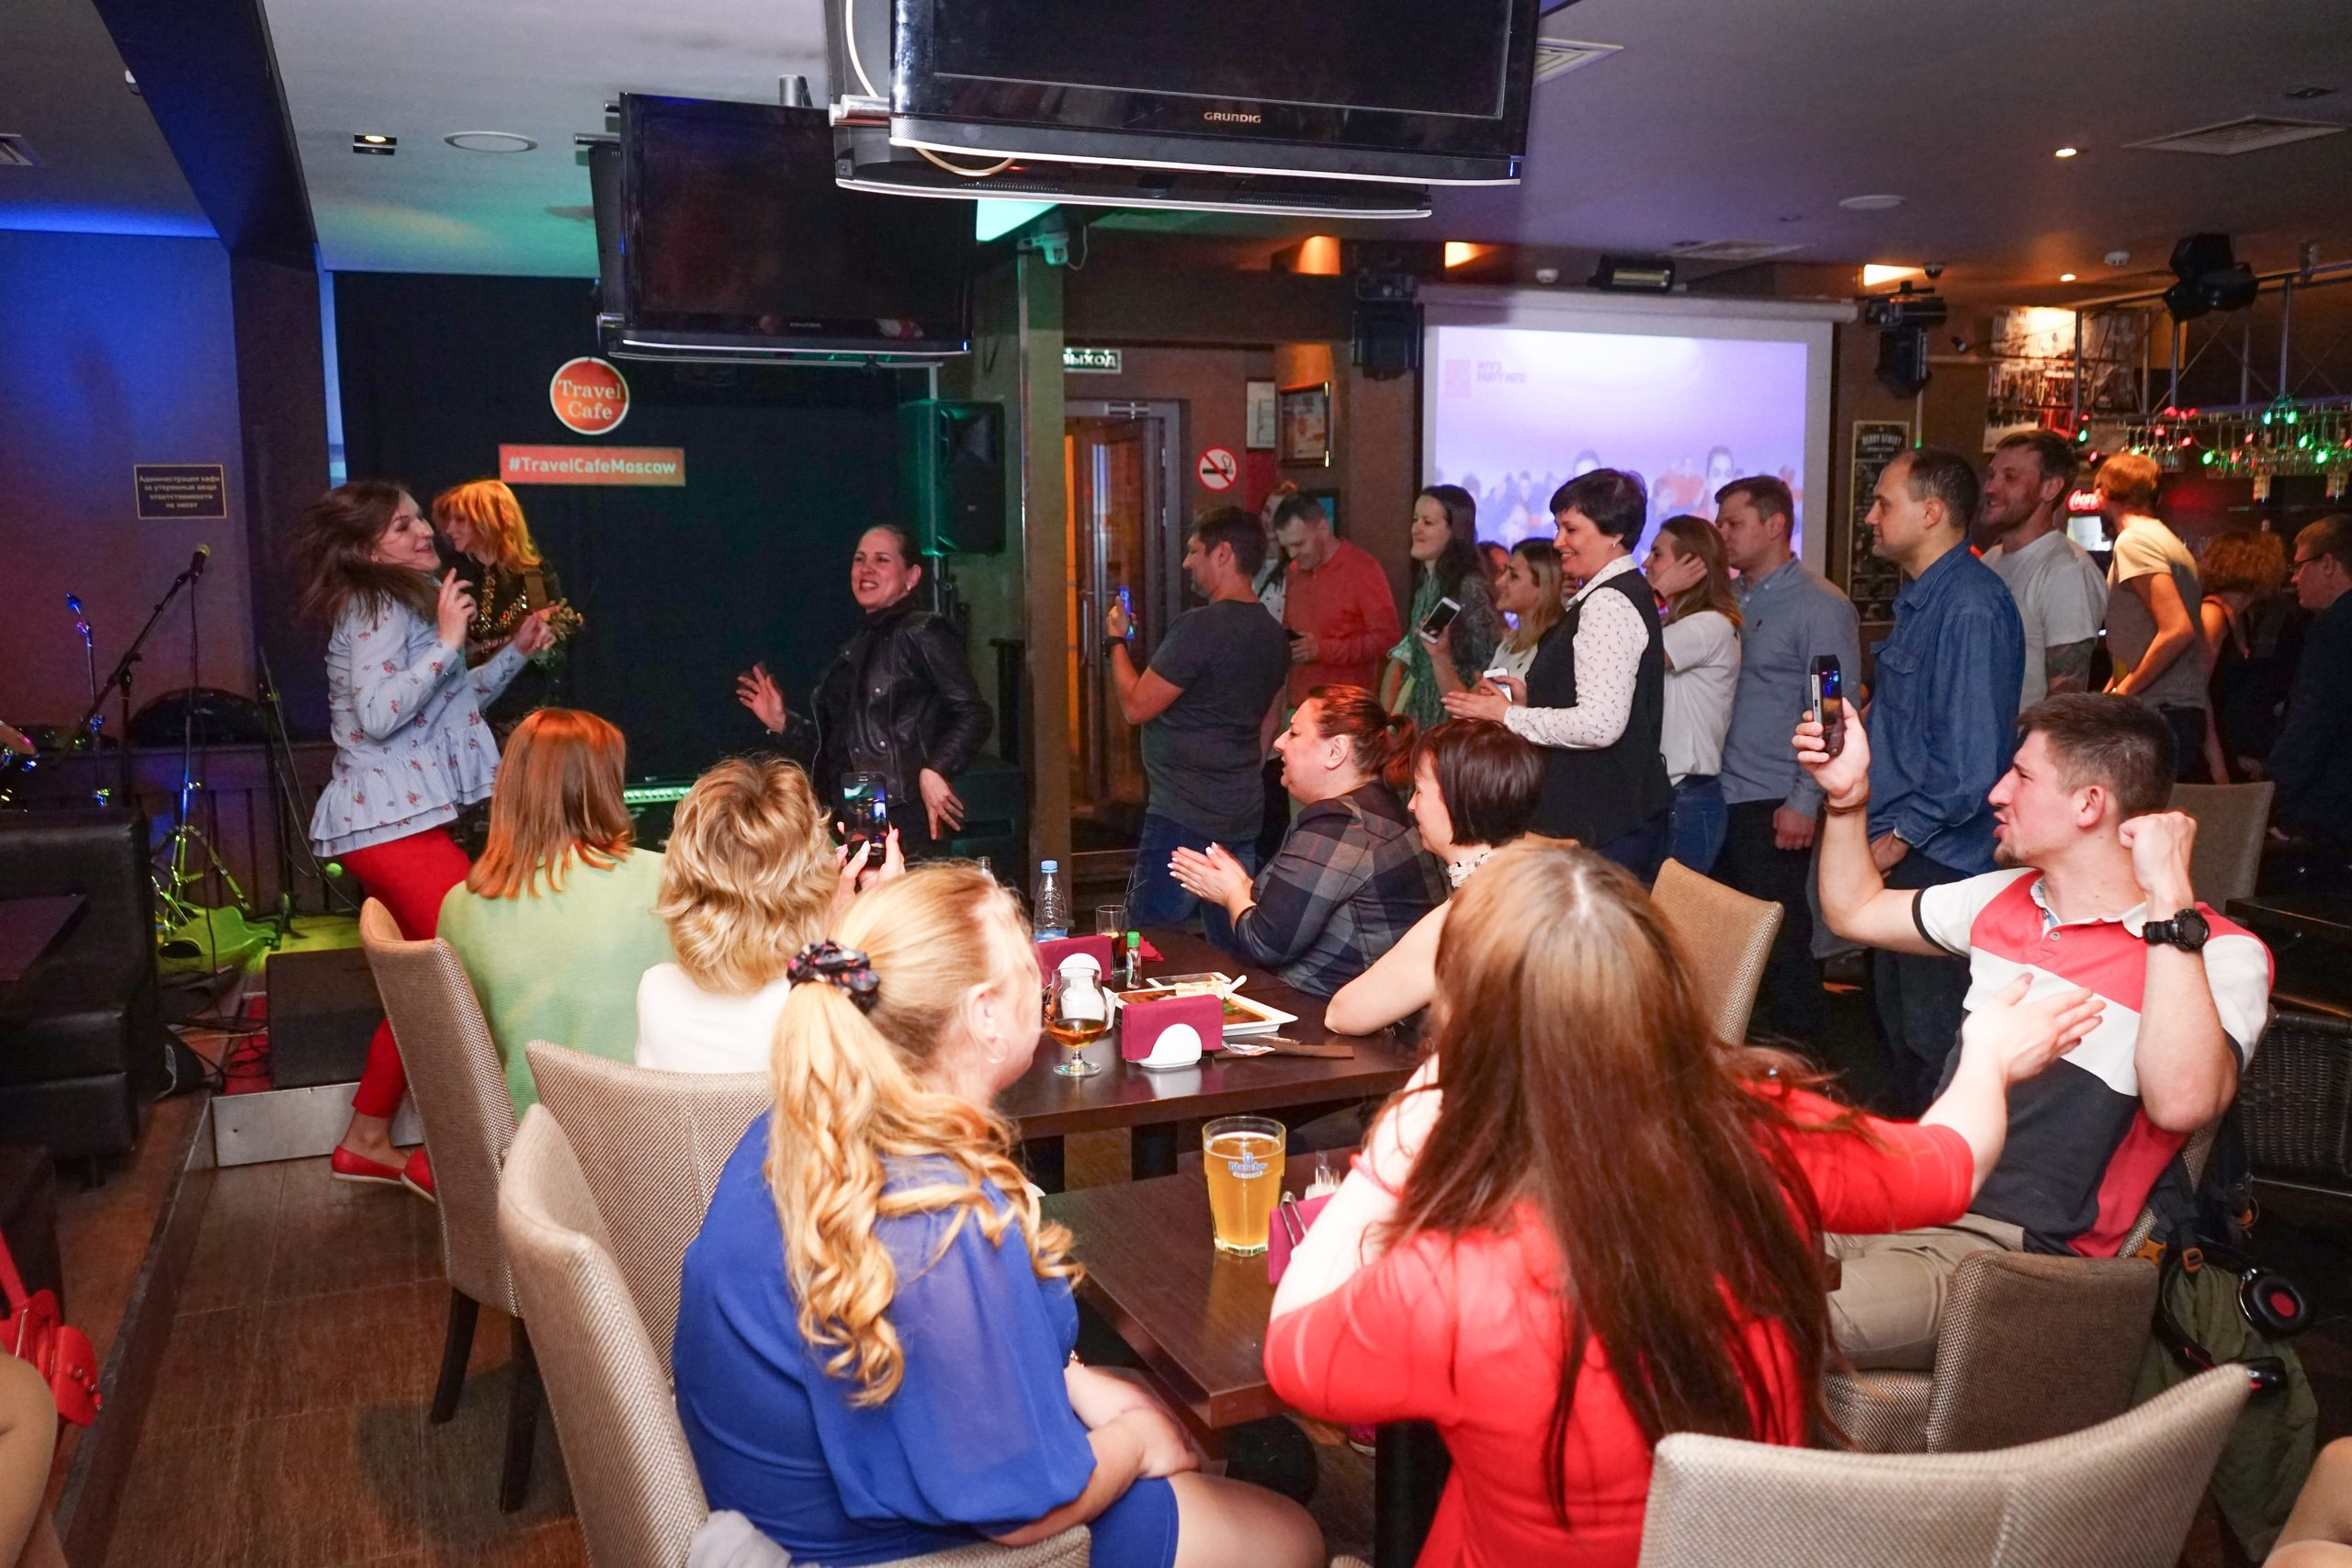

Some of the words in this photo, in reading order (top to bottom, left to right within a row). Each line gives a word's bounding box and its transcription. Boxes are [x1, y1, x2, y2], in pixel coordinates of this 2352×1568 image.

[1204, 111, 1261, 123] GRUNDIG
[558, 379, 622, 400] Travel
[568, 400, 613, 420] Cafe
[508, 457, 677, 474] #TravelCafeMoscow
